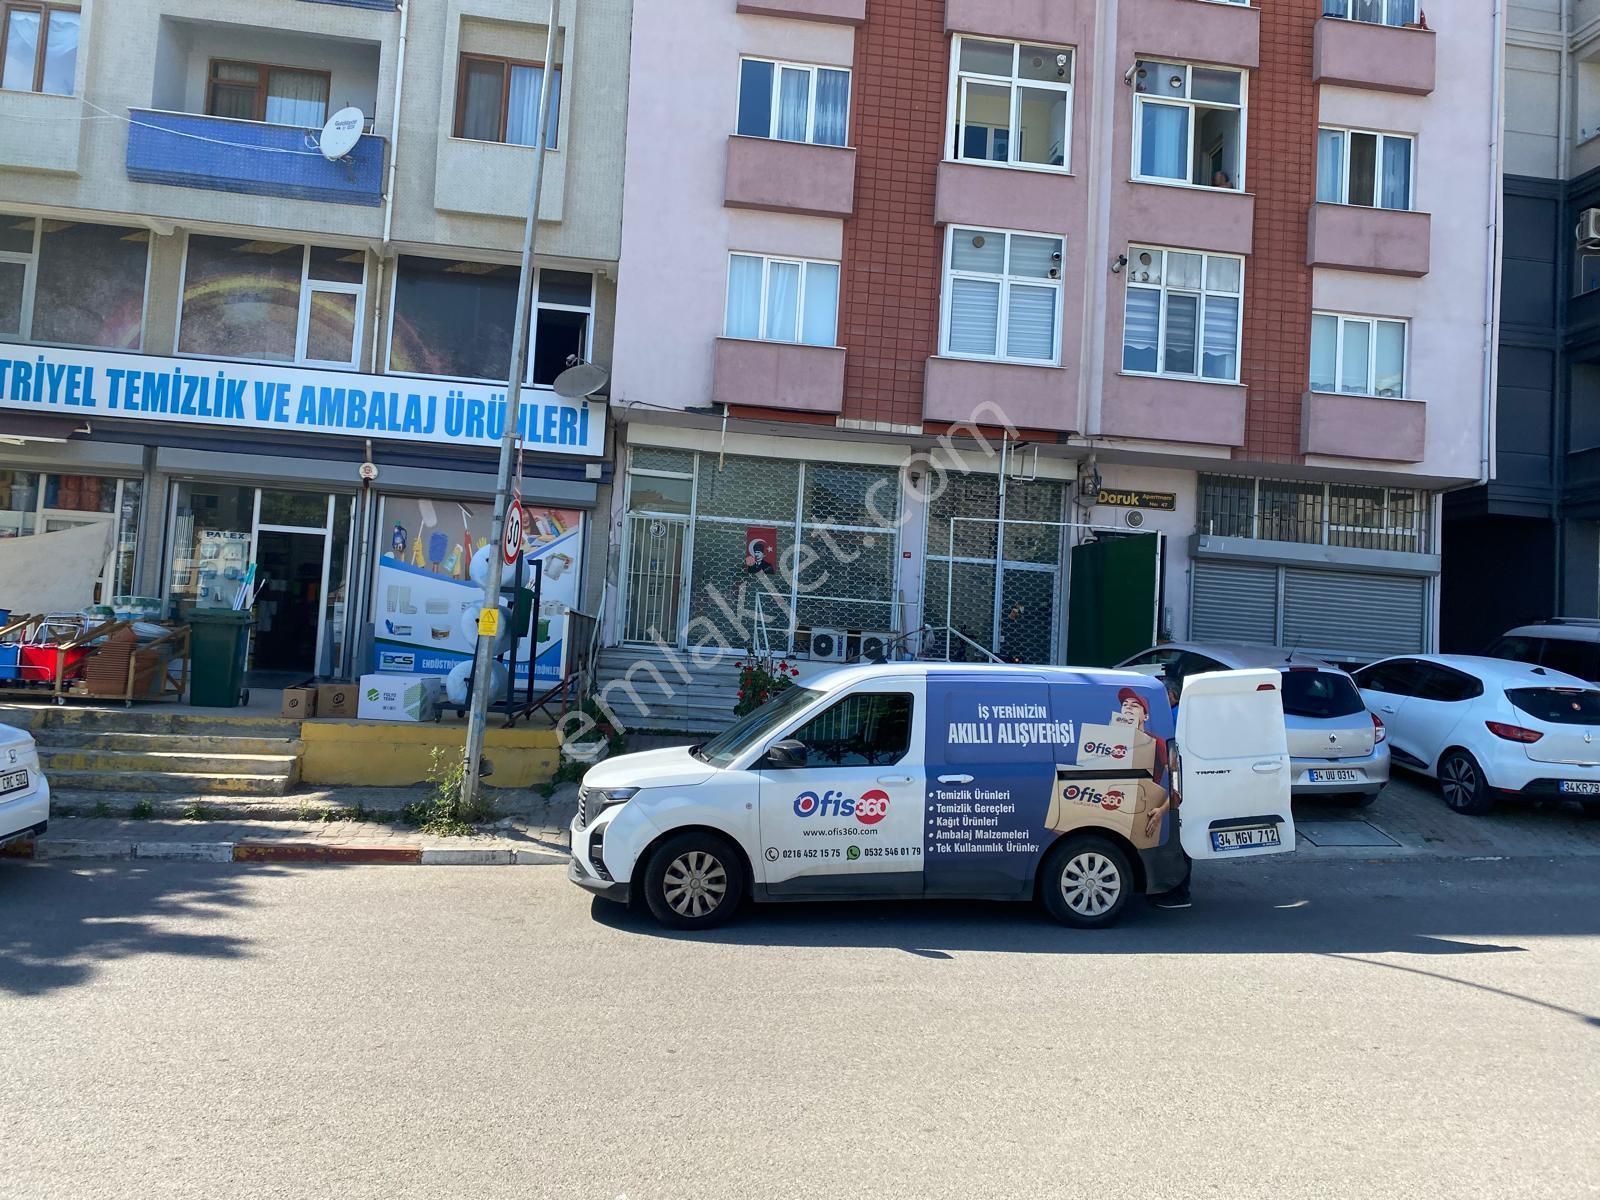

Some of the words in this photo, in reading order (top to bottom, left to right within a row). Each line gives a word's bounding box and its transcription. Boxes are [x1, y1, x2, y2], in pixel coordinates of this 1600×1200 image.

[0, 355, 96, 407] TRİYEL
[106, 367, 247, 419] TEMİZLİK
[255, 381, 291, 423] VE
[296, 385, 437, 434] AMBALAJ
[444, 390, 589, 446] ÜRÜNLERİ
[1098, 491, 1139, 505] Doruk
[206, 531, 247, 540] PALEX
[507, 516, 520, 548] 30
[383, 655, 414, 665] BCS
[978, 703, 990, 720] İŞ
[992, 703, 1047, 719] YERİNİZİN
[948, 722, 993, 744] AKILLI
[998, 720, 1075, 747] ALIŞVERİŞİ
[1313, 771, 1324, 781] 34
[1337, 770, 1355, 780] 0314
[936, 790, 972, 800] Temizlik
[974, 788, 1010, 800] Ürünleri
[793, 789, 890, 824] Ofis360
[936, 803, 972, 813] Temizlik
[974, 803, 1015, 815] Gereçleri
[936, 816, 960, 828] Kağıt
[962, 814, 998, 826] Ürünleri
[803, 828, 878, 837] www.ofis360.com
[936, 830, 972, 840] Ambalaj
[974, 829, 1029, 840] Malzemeleri
[1218, 833, 1231, 846] 34
[1235, 831, 1253, 845] MGV
[1257, 829, 1277, 843] 712
[782, 849, 802, 859] 0216
[804, 849, 818, 858] 452
[820, 849, 830, 858] 15
[831, 848, 841, 858] 75
[864, 847, 883, 857] 0532
[885, 847, 899, 857] 546
[900, 847, 910, 856] 01
[912, 846, 921, 856] 79
[936, 843, 952, 853] Tek
[954, 843, 1004, 853] Kullanımlık
